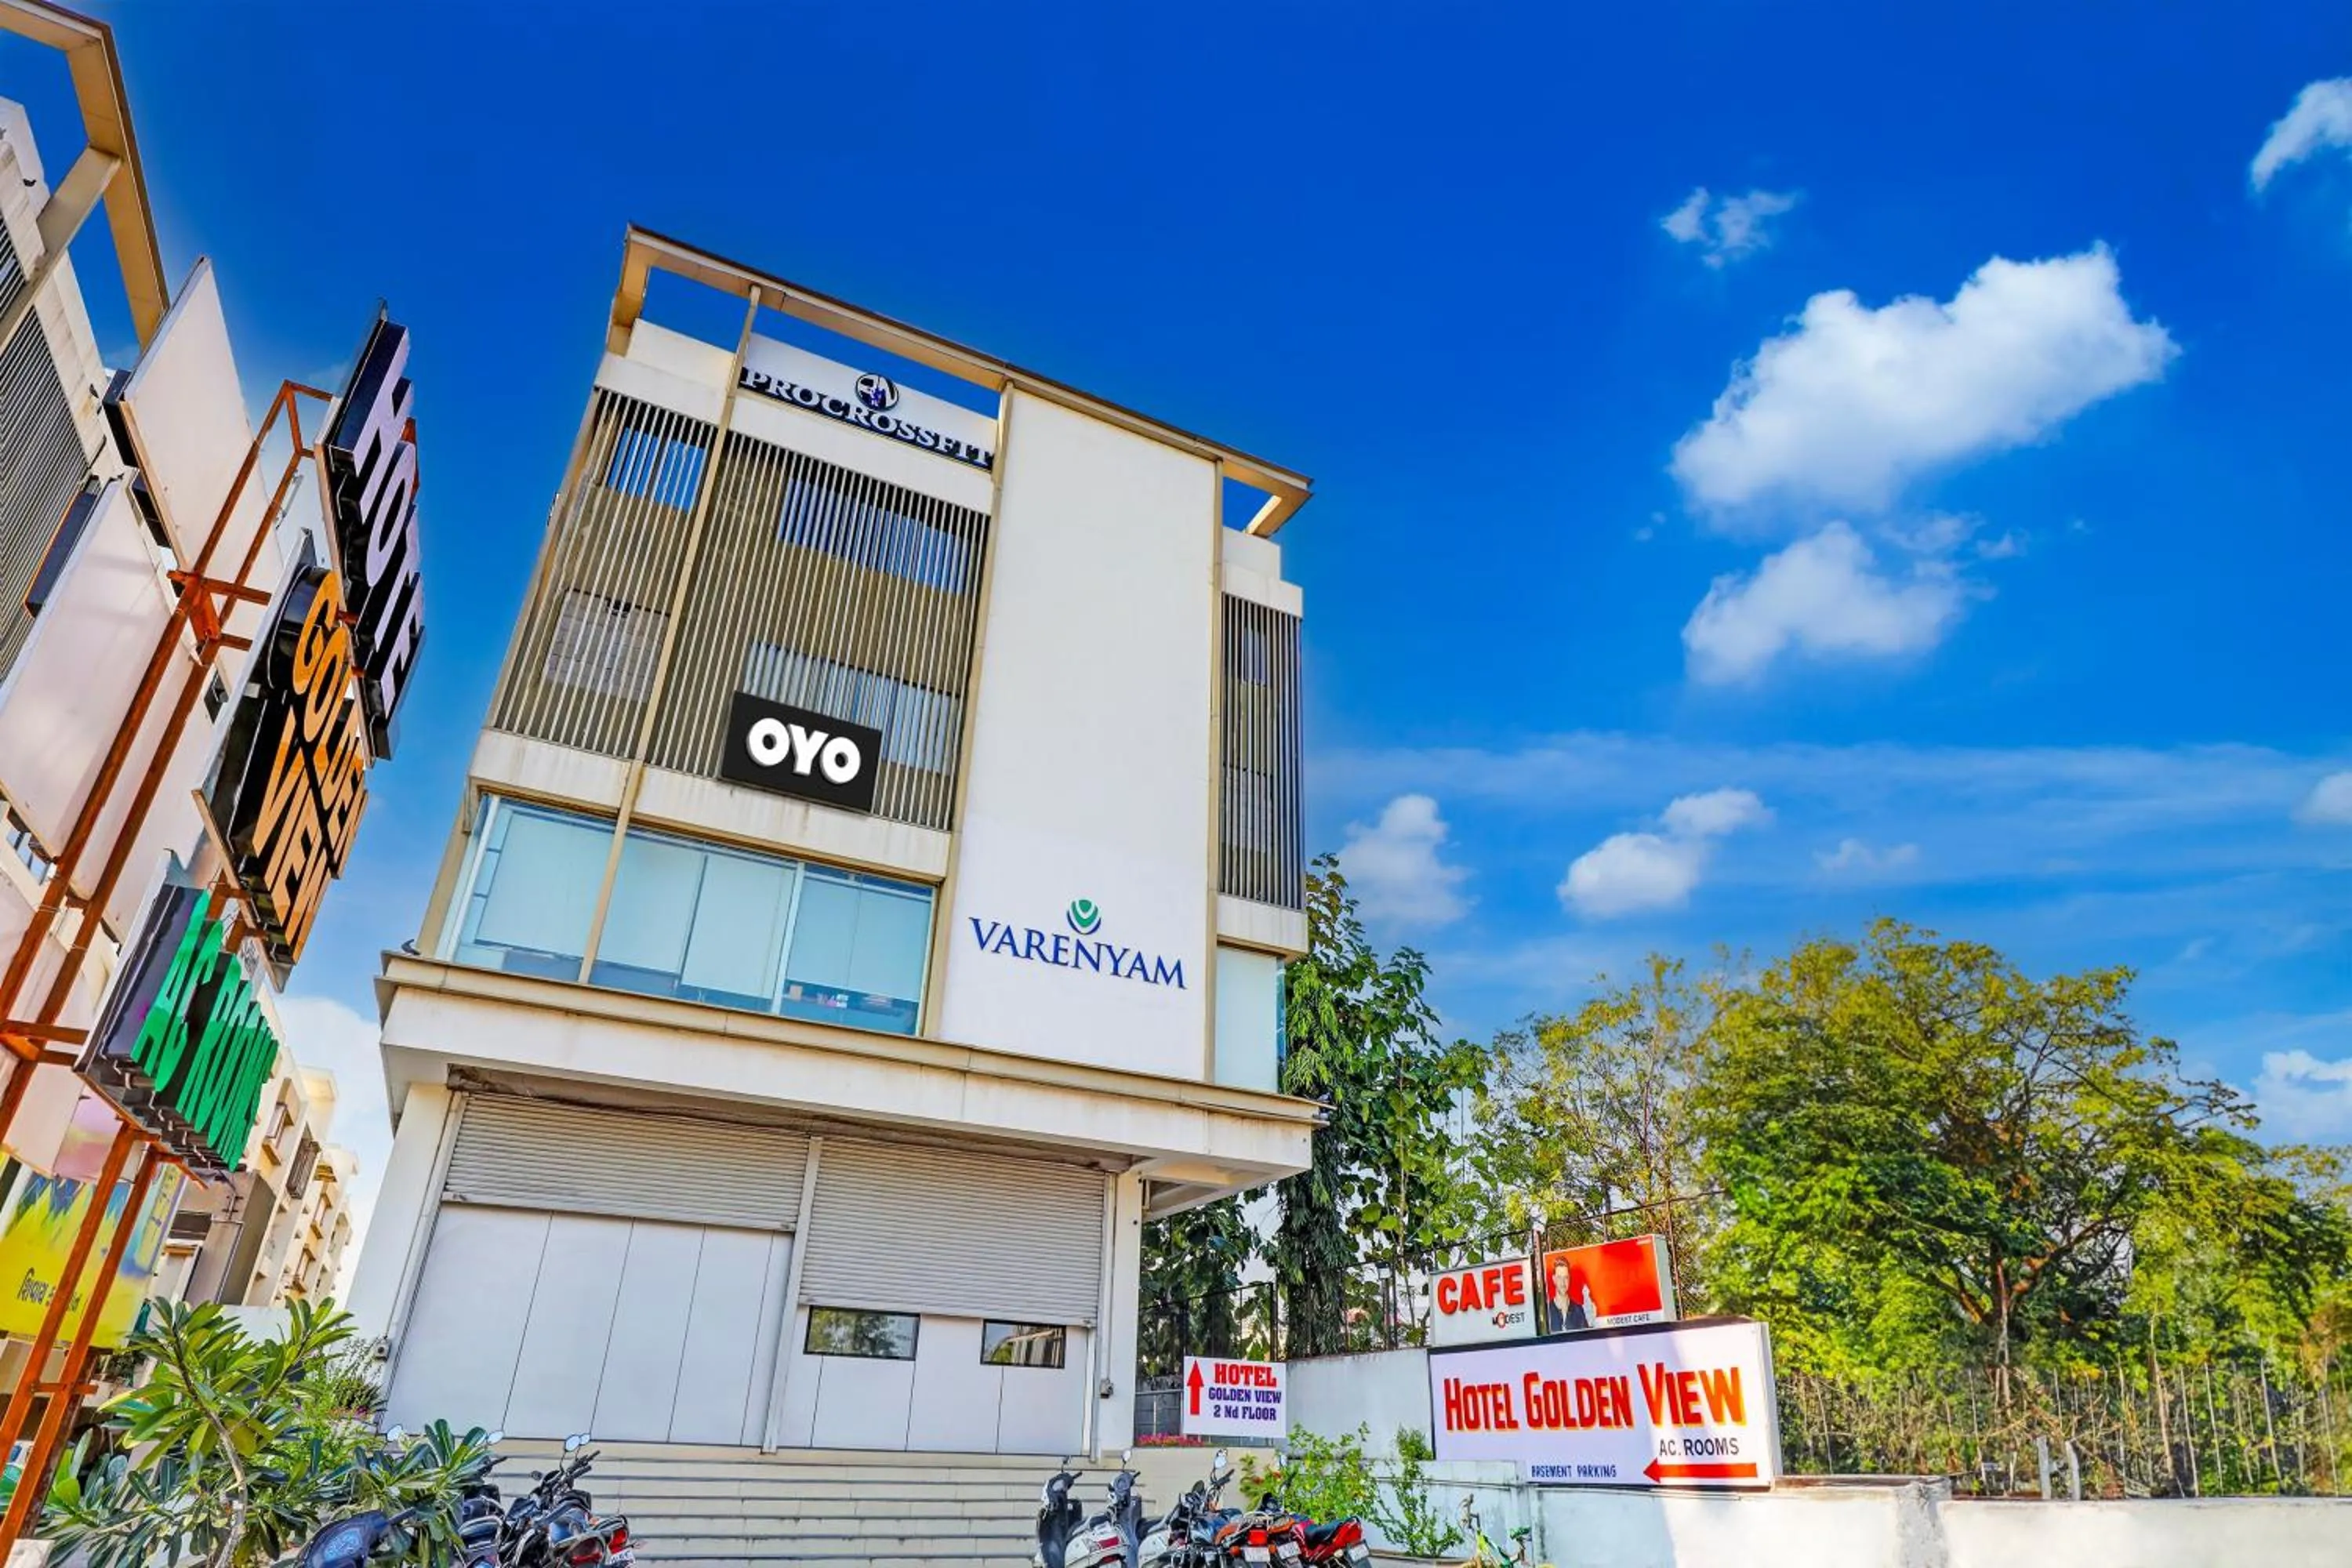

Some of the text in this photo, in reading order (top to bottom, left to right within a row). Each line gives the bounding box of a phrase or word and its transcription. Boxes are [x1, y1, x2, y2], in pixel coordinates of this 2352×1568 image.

[739, 368, 990, 466] PROCROSSFIT
[292, 570, 368, 878] GOLDEN
[747, 717, 862, 784] OYO
[252, 704, 332, 964] VIEW
[968, 916, 1188, 989] VARENYAM
[130, 888, 224, 1092] AC
[1437, 1264, 1526, 1316] CAFE
[1492, 1312, 1525, 1328] MODEST
[1208, 1387, 1282, 1404] GOLDEN VIEW
[1214, 1363, 1277, 1388] HOTEL
[1443, 1361, 1747, 1432] HOTEL GOLDEN VIEW
[1214, 1404, 1276, 1421] 2 Nd FLOOR
[1531, 1464, 1617, 1478] BASEMENT PARKING
[1683, 1437, 1740, 1456] ROOMS
